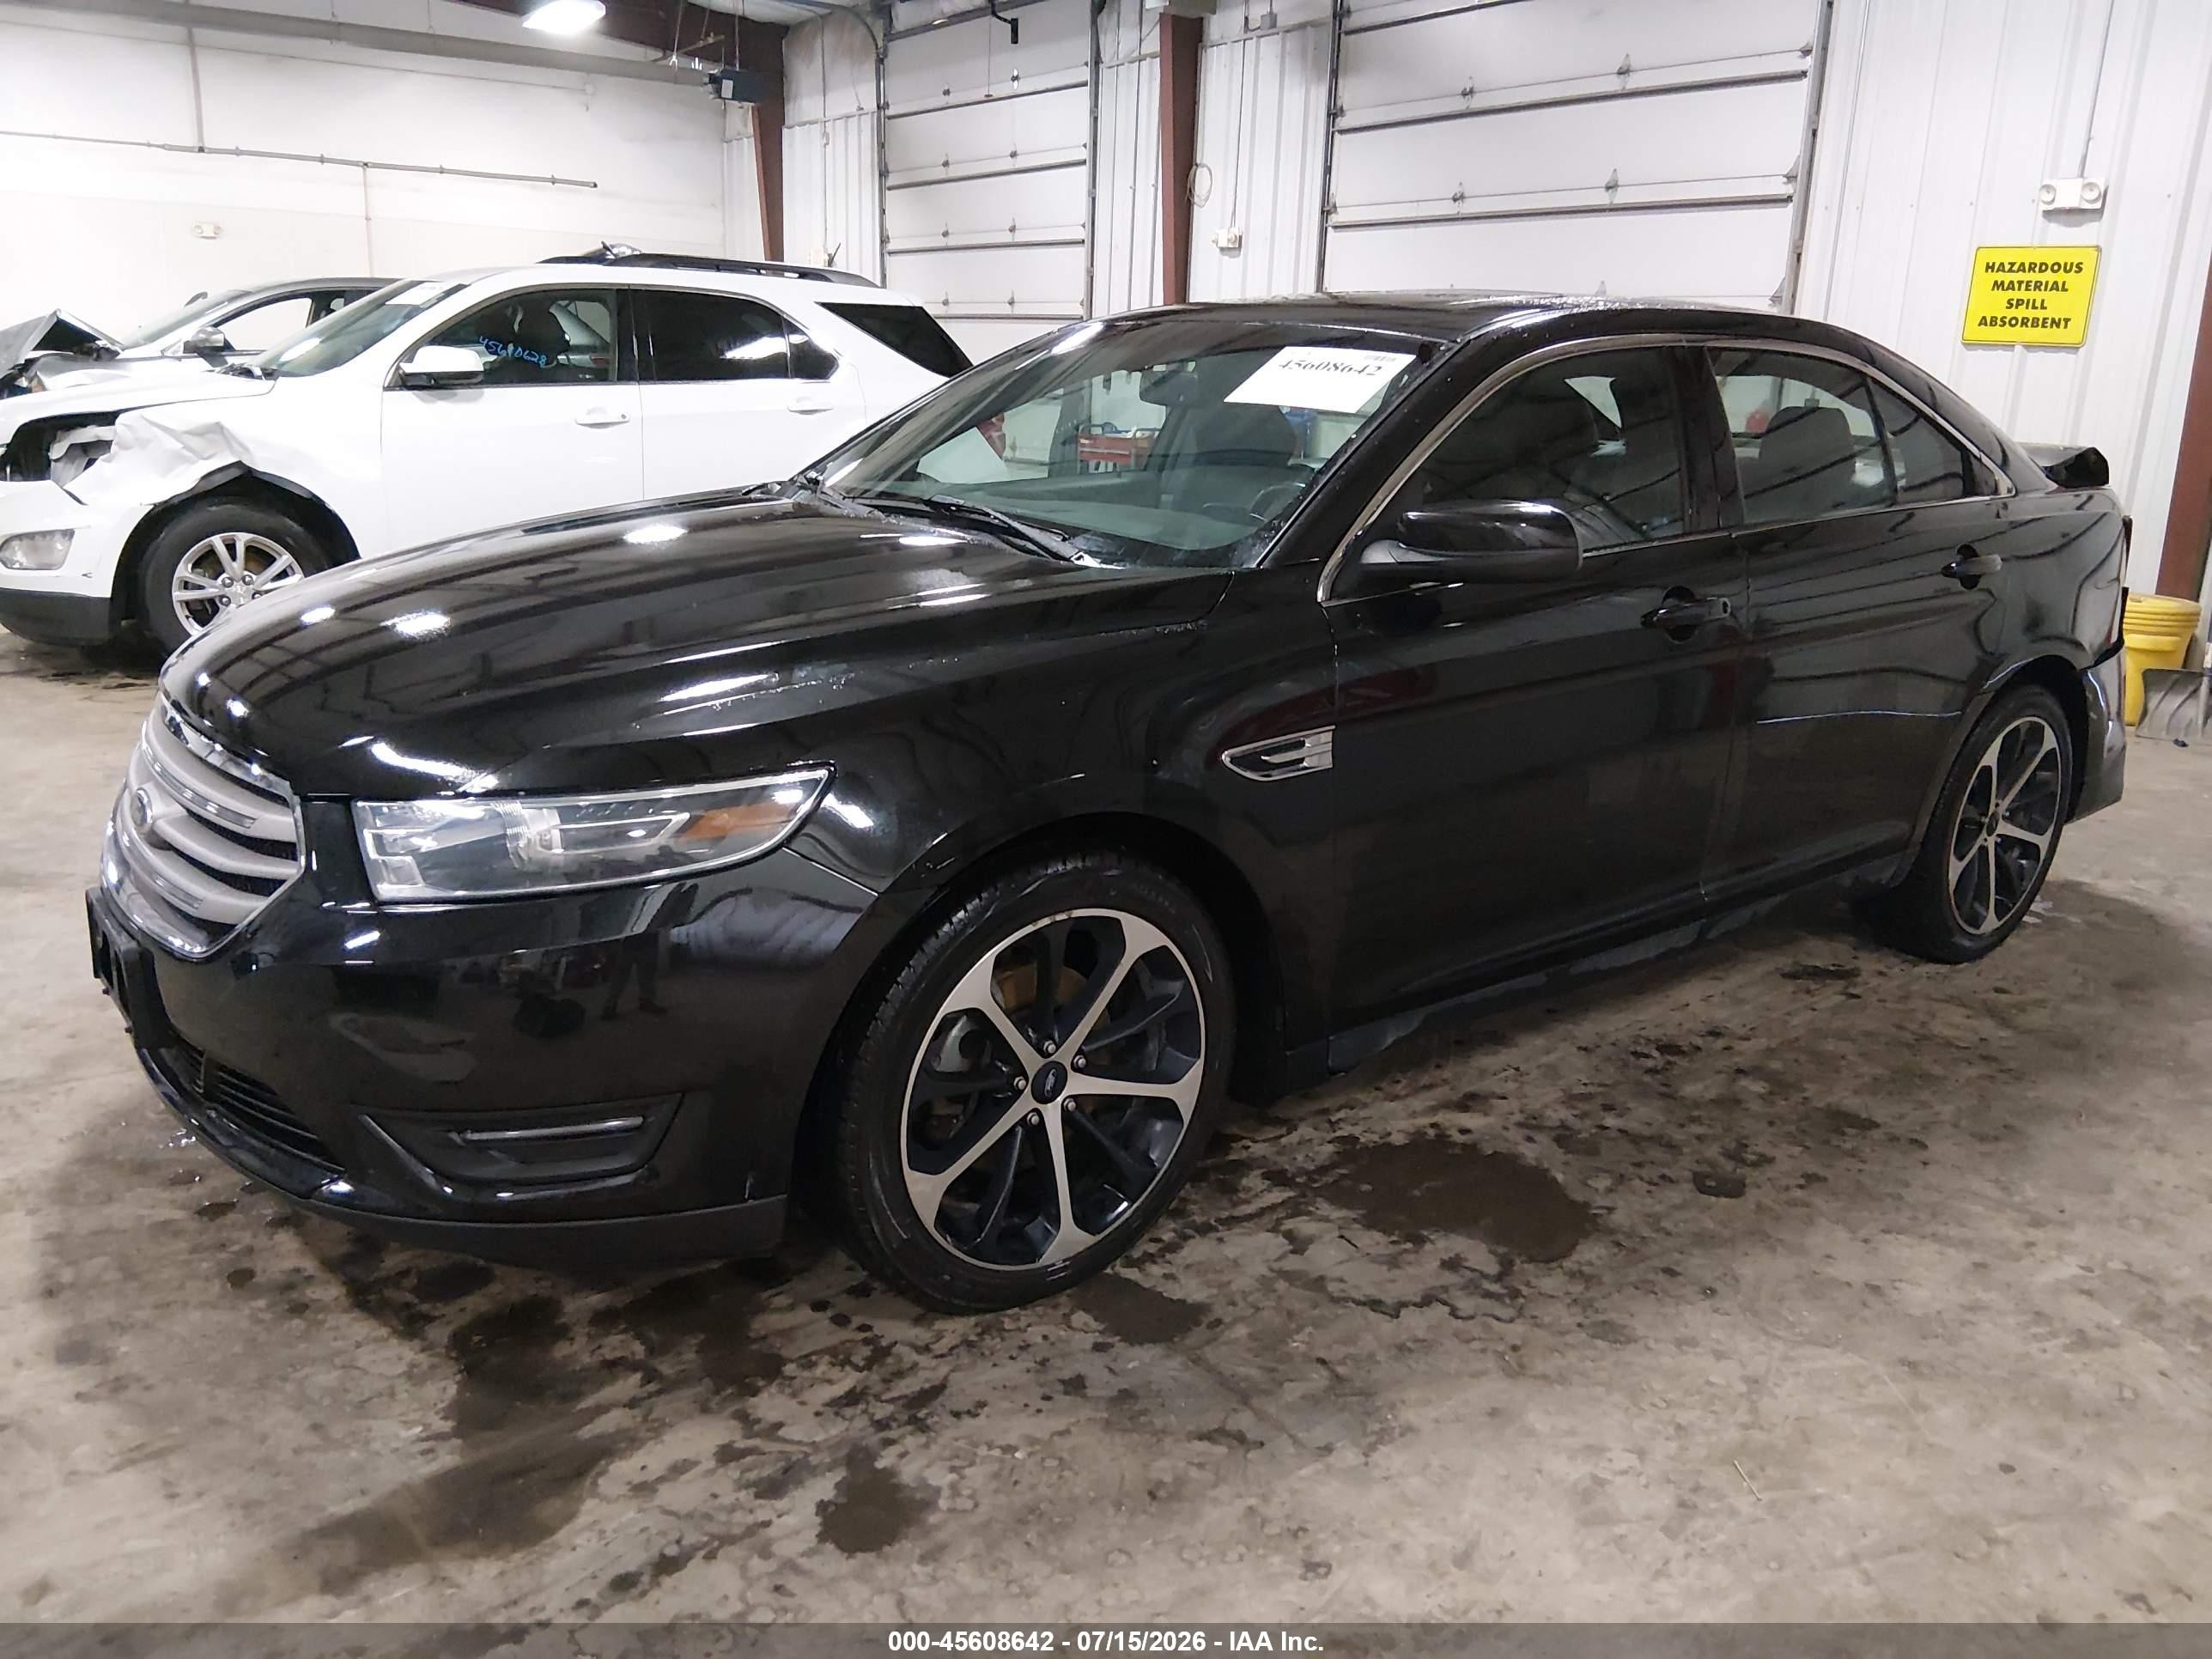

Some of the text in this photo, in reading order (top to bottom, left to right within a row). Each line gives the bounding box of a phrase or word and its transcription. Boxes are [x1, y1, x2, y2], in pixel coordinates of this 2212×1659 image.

[1984, 261, 2084, 274] HAZARDOUS
[1990, 279, 2069, 292] MATERIAL
[2005, 298, 2048, 310] SPILL
[1978, 315, 2071, 329] ABSORBENT
